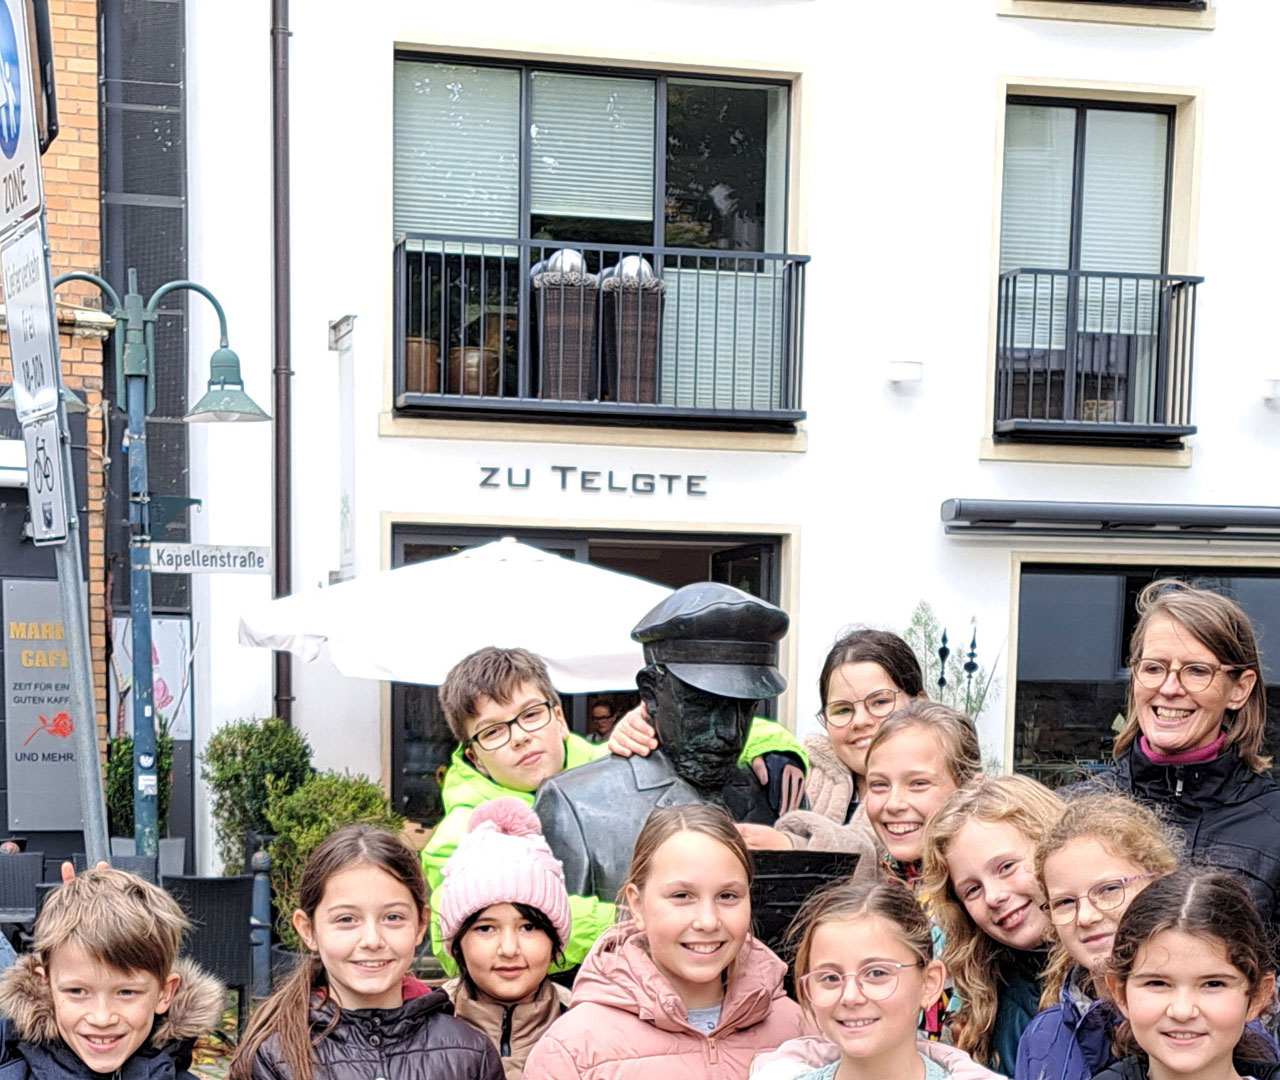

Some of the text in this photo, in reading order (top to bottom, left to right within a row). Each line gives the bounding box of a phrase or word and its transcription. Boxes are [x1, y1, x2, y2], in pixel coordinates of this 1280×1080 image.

[2, 163, 28, 214] ZONE
[21, 306, 37, 343] frei
[156, 549, 265, 571] Kapellenstraße
[8, 621, 65, 640] MARK
[12, 681, 70, 692] ZEIT FÜR EIN
[13, 696, 72, 705] GUTEN KAFF
[14, 752, 39, 762] UND
